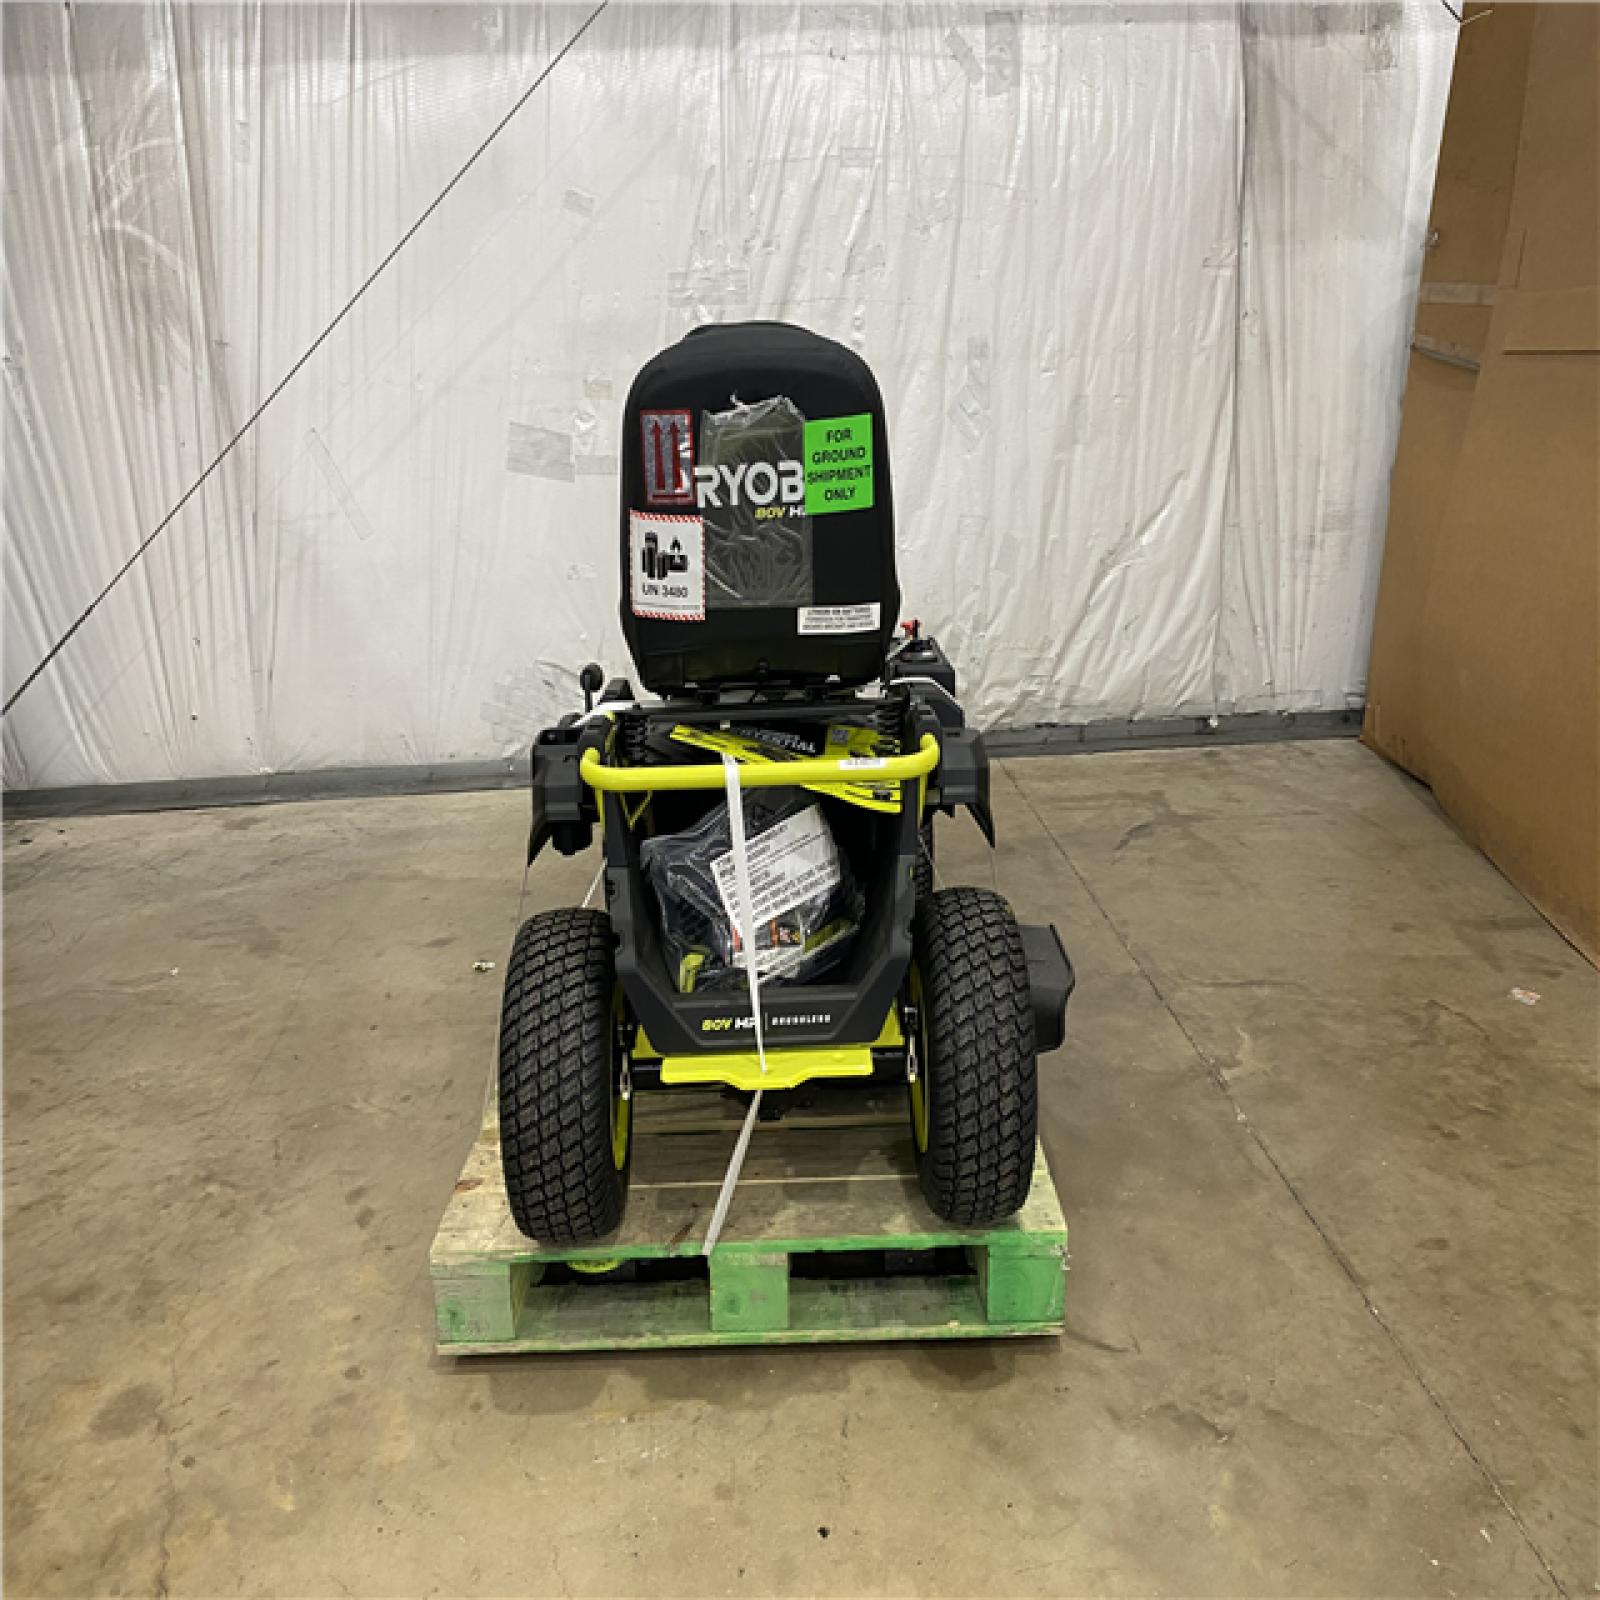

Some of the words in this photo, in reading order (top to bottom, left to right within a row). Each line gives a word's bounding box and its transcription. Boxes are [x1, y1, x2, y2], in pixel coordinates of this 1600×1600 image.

[825, 427, 853, 443] FOR
[812, 446, 866, 465] GROUND
[807, 464, 871, 485] SHIPMENT
[694, 460, 805, 508] RYOB
[824, 487, 856, 502] ONLY
[789, 505, 806, 519] H
[642, 582, 659, 596] UN
